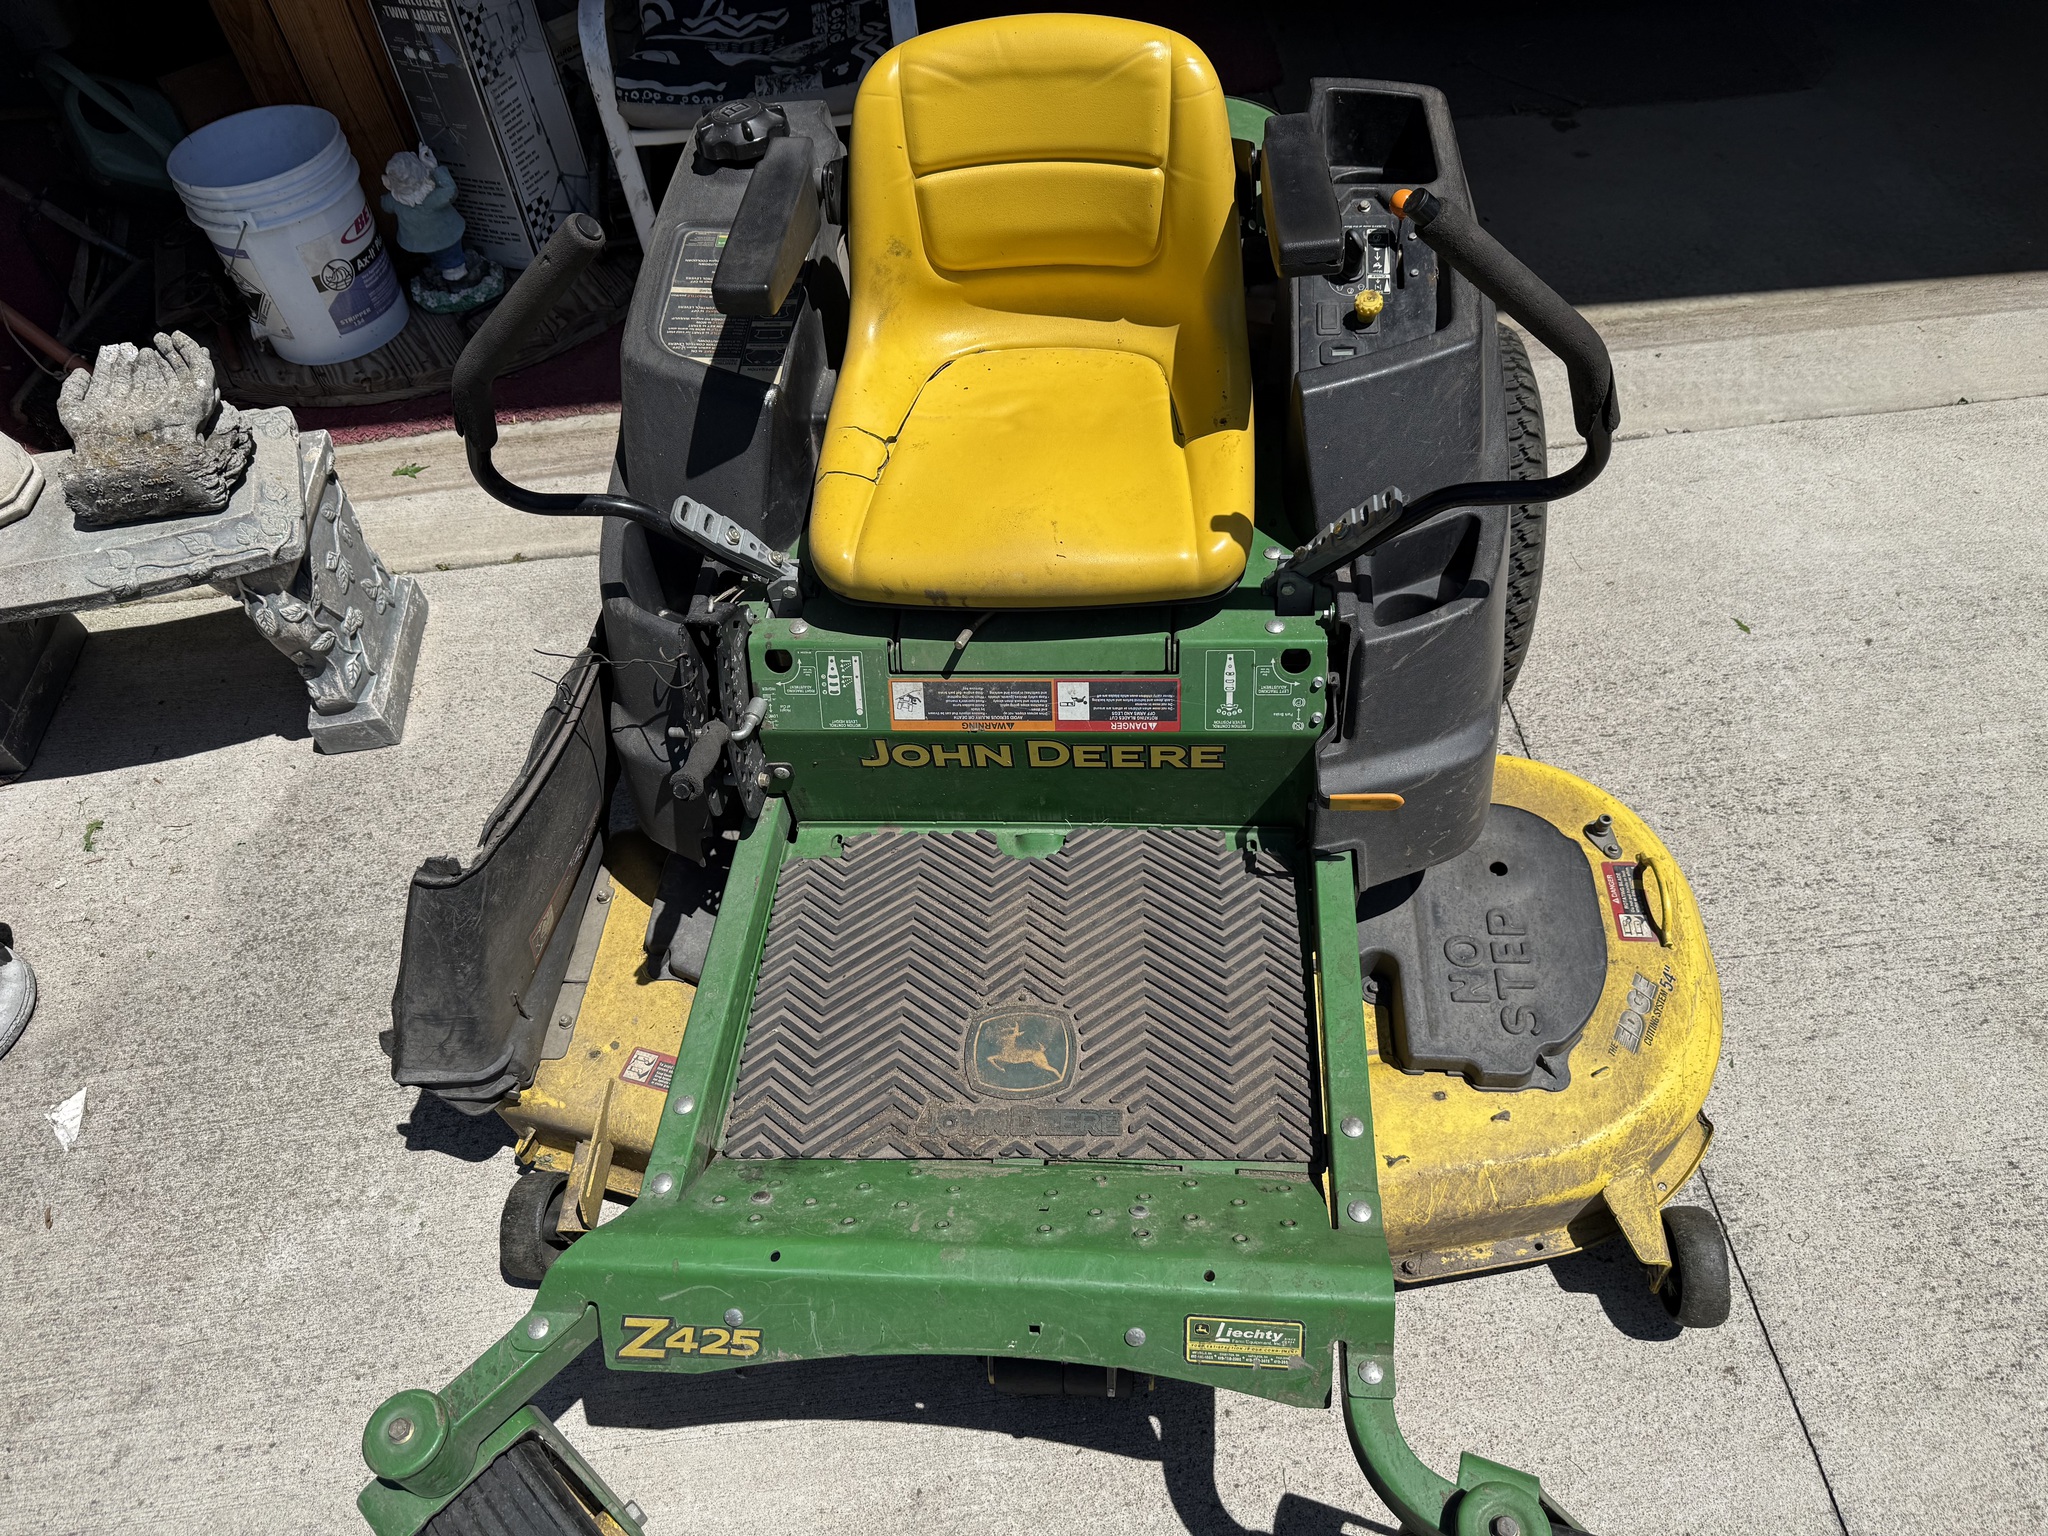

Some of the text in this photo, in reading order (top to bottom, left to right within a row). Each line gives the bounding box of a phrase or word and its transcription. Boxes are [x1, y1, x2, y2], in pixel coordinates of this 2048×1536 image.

[382, 5, 447, 23] TWIN LIGHTS
[427, 24, 451, 35] TRIPOD
[340, 307, 371, 326] STRIPPER
[120, 493, 136, 503] all
[962, 722, 1006, 730] WARNING
[861, 739, 1226, 768] JOHN DEERE
[1606, 874, 1617, 897] DANGER
[1444, 935, 1490, 1003] NO
[1486, 908, 1542, 1036] STEP
[1608, 971, 1657, 1057] THE EDGE
[1643, 965, 1676, 1046] CUTTING SYSTEM 54"
[618, 1317, 760, 1358] Z425
[1215, 1322, 1284, 1342] Liechty
